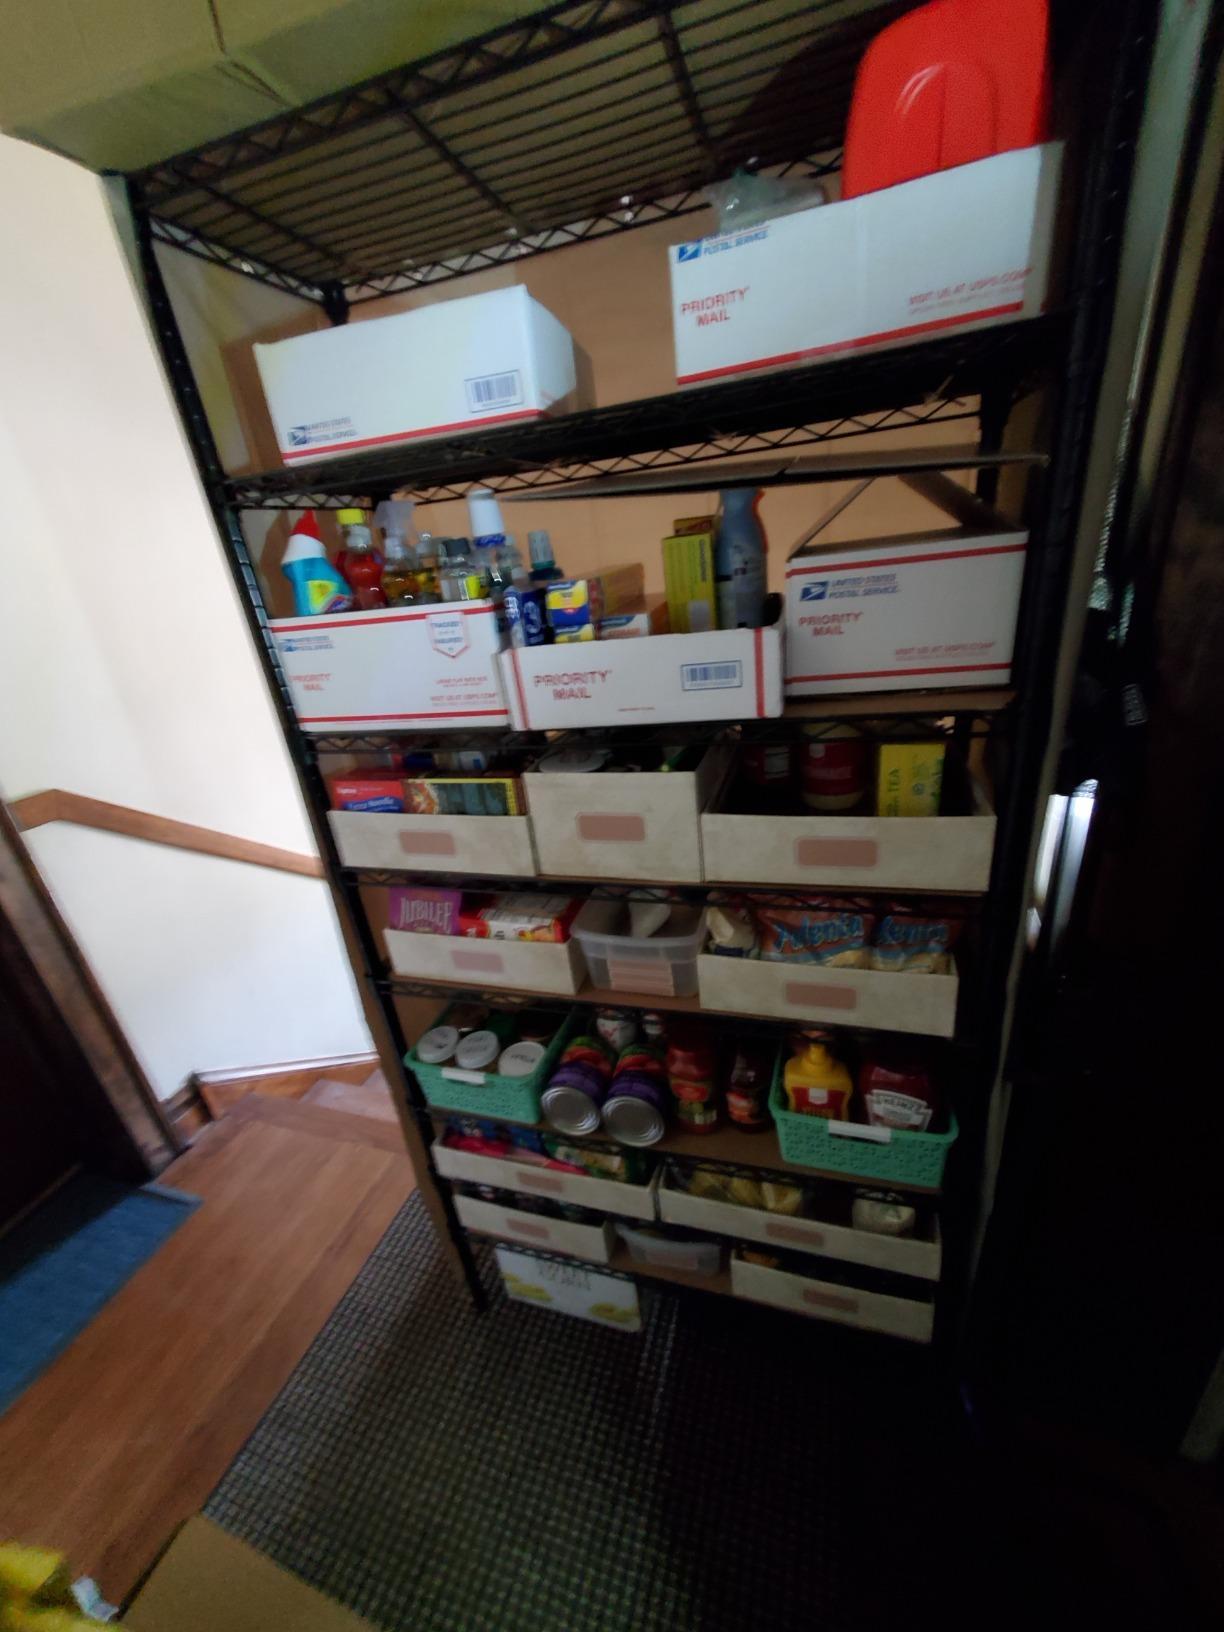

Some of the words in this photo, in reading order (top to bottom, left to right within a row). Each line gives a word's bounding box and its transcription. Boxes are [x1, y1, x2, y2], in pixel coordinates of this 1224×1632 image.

[681, 287, 747, 314] PRIORITY
[697, 308, 730, 326] MAIL
[829, 589, 860, 599] POSTAL
[862, 586, 898, 596] SERVICE
[799, 611, 861, 627] PRIORITY
[812, 625, 844, 636] MAIL
[534, 670, 608, 687] PRIORITY
[552, 686, 592, 700] MAIL
